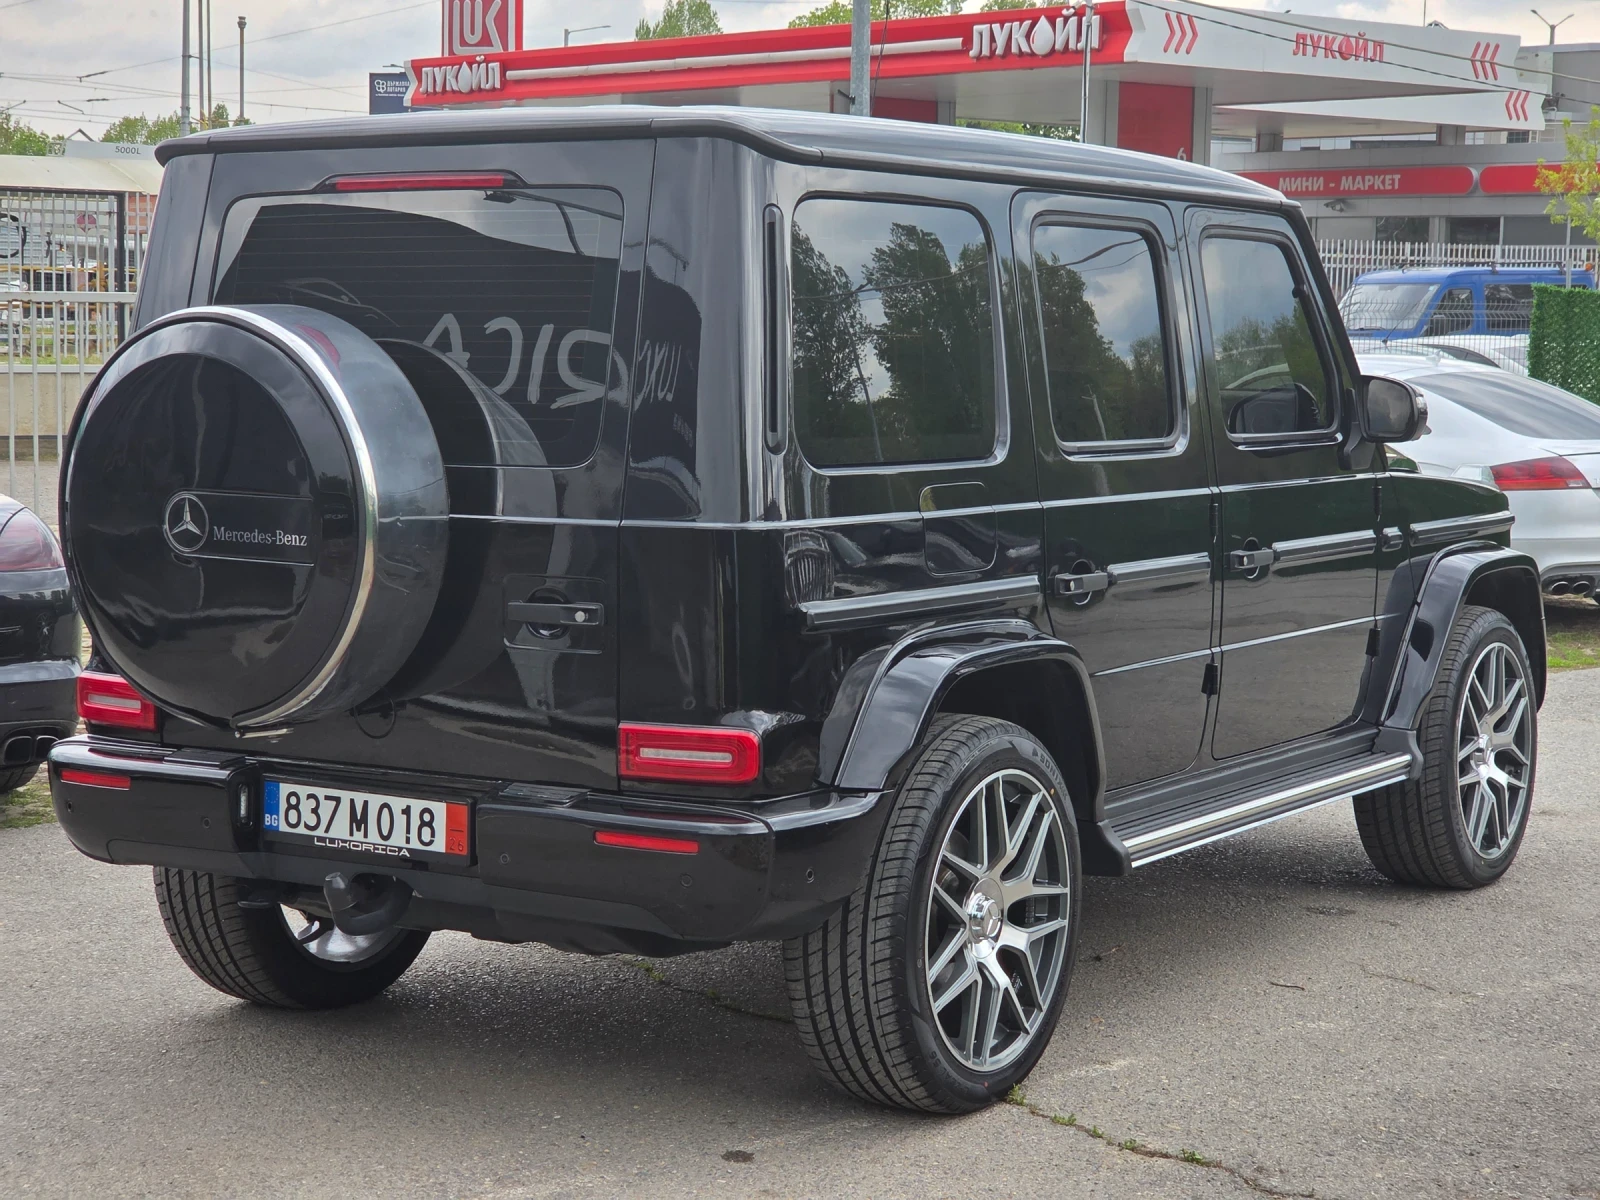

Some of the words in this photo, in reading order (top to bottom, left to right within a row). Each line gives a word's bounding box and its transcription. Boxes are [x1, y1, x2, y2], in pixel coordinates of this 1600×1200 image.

[969, 7, 1101, 58] ЛУКОЙЛ
[1293, 30, 1385, 63] ЛУКОЙЛ
[420, 55, 501, 93] ЛУКОЙЛ
[115, 145, 141, 155] 5000L
[1279, 176, 1324, 192] МИНИ
[1340, 175, 1402, 191] МАРКЕТ
[213, 526, 308, 547] Mercedes-Benz
[264, 813, 279, 827] BG
[314, 836, 411, 858] LUXORICA
